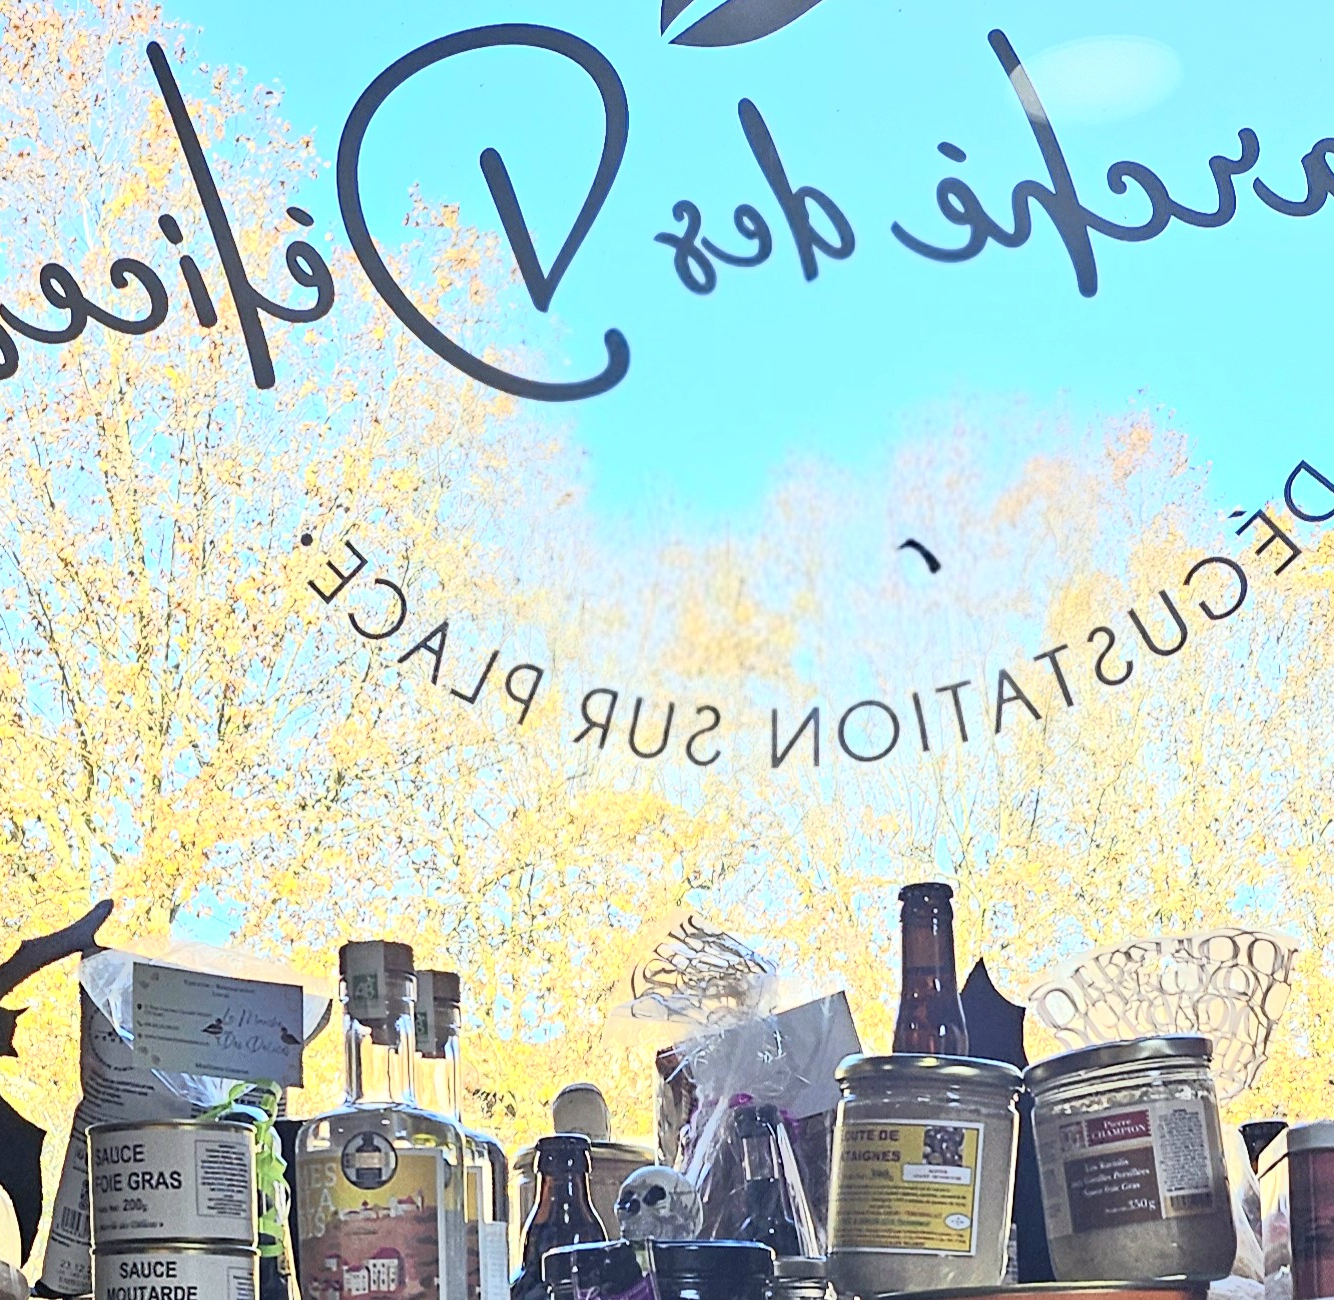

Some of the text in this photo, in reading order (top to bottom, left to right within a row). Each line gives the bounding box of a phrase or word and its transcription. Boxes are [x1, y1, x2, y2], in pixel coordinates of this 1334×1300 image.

[1091, 1124, 1146, 1140] CHAMPION
[95, 1144, 145, 1164] SAUCE
[127, 1171, 182, 1191] GRAS
[119, 1261, 177, 1279] SAUCE
